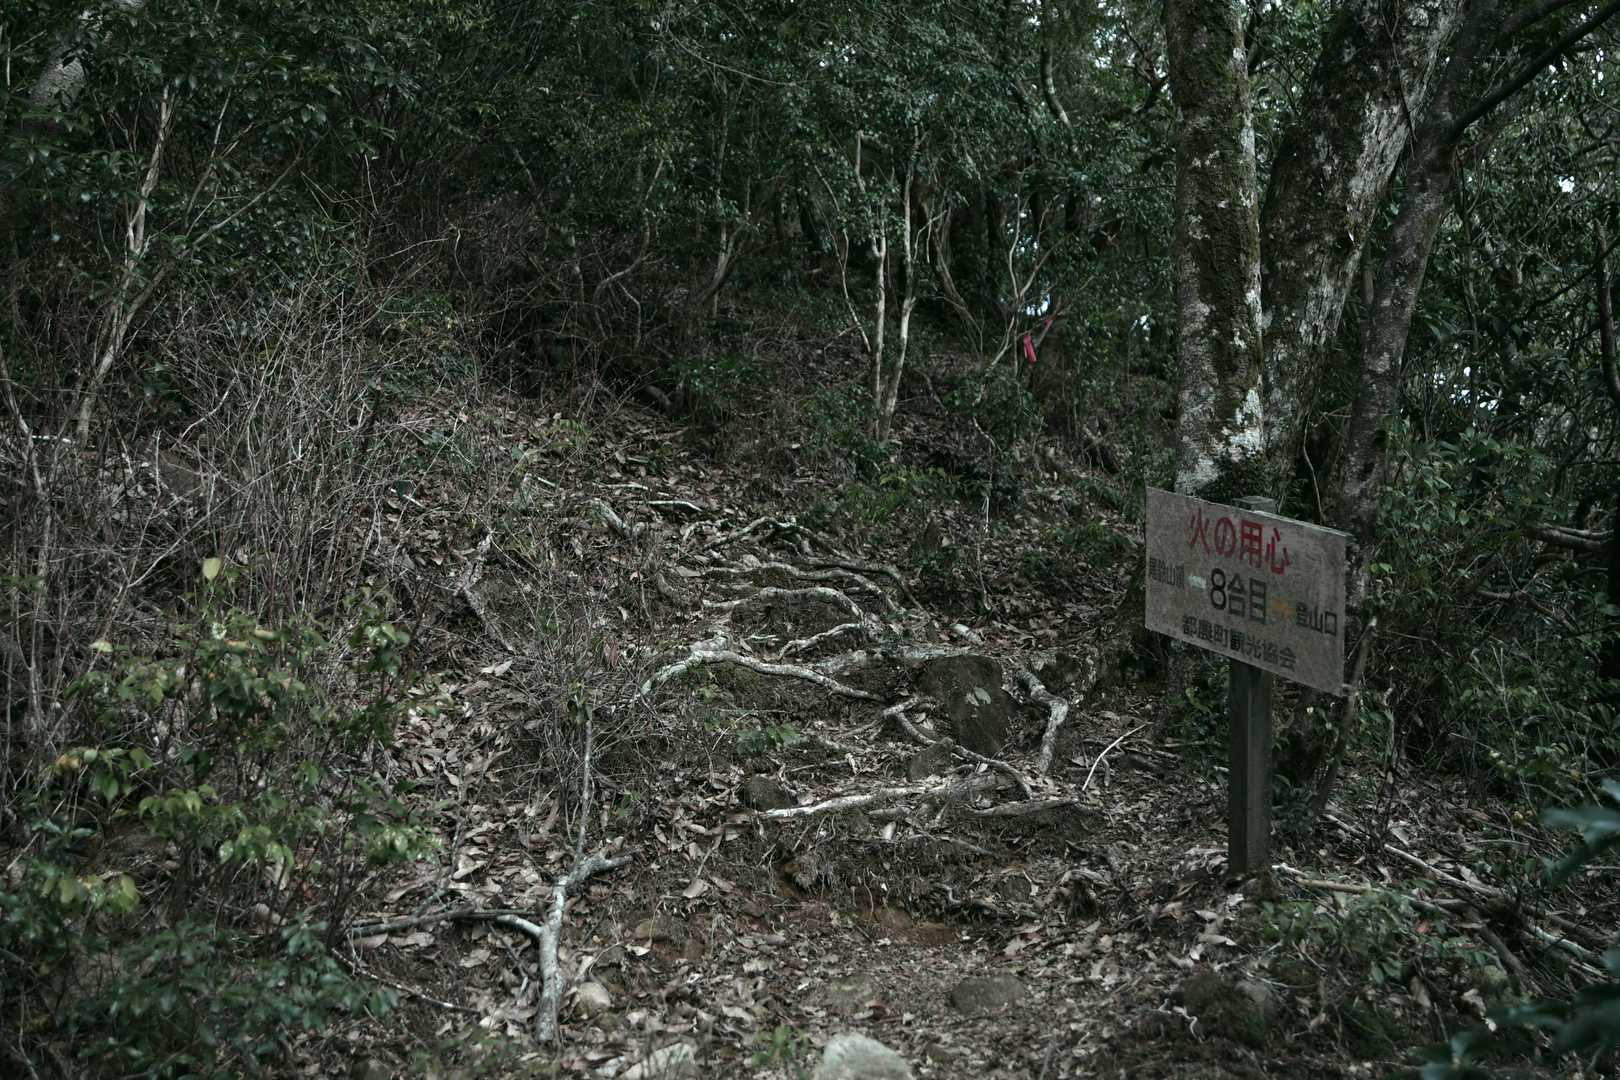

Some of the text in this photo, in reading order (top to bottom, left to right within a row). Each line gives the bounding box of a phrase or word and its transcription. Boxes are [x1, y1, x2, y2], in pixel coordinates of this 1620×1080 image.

[1189, 507, 1291, 576] 火の用心
[1210, 567, 1267, 625] 8合目
[1296, 601, 1338, 637] 登山口
